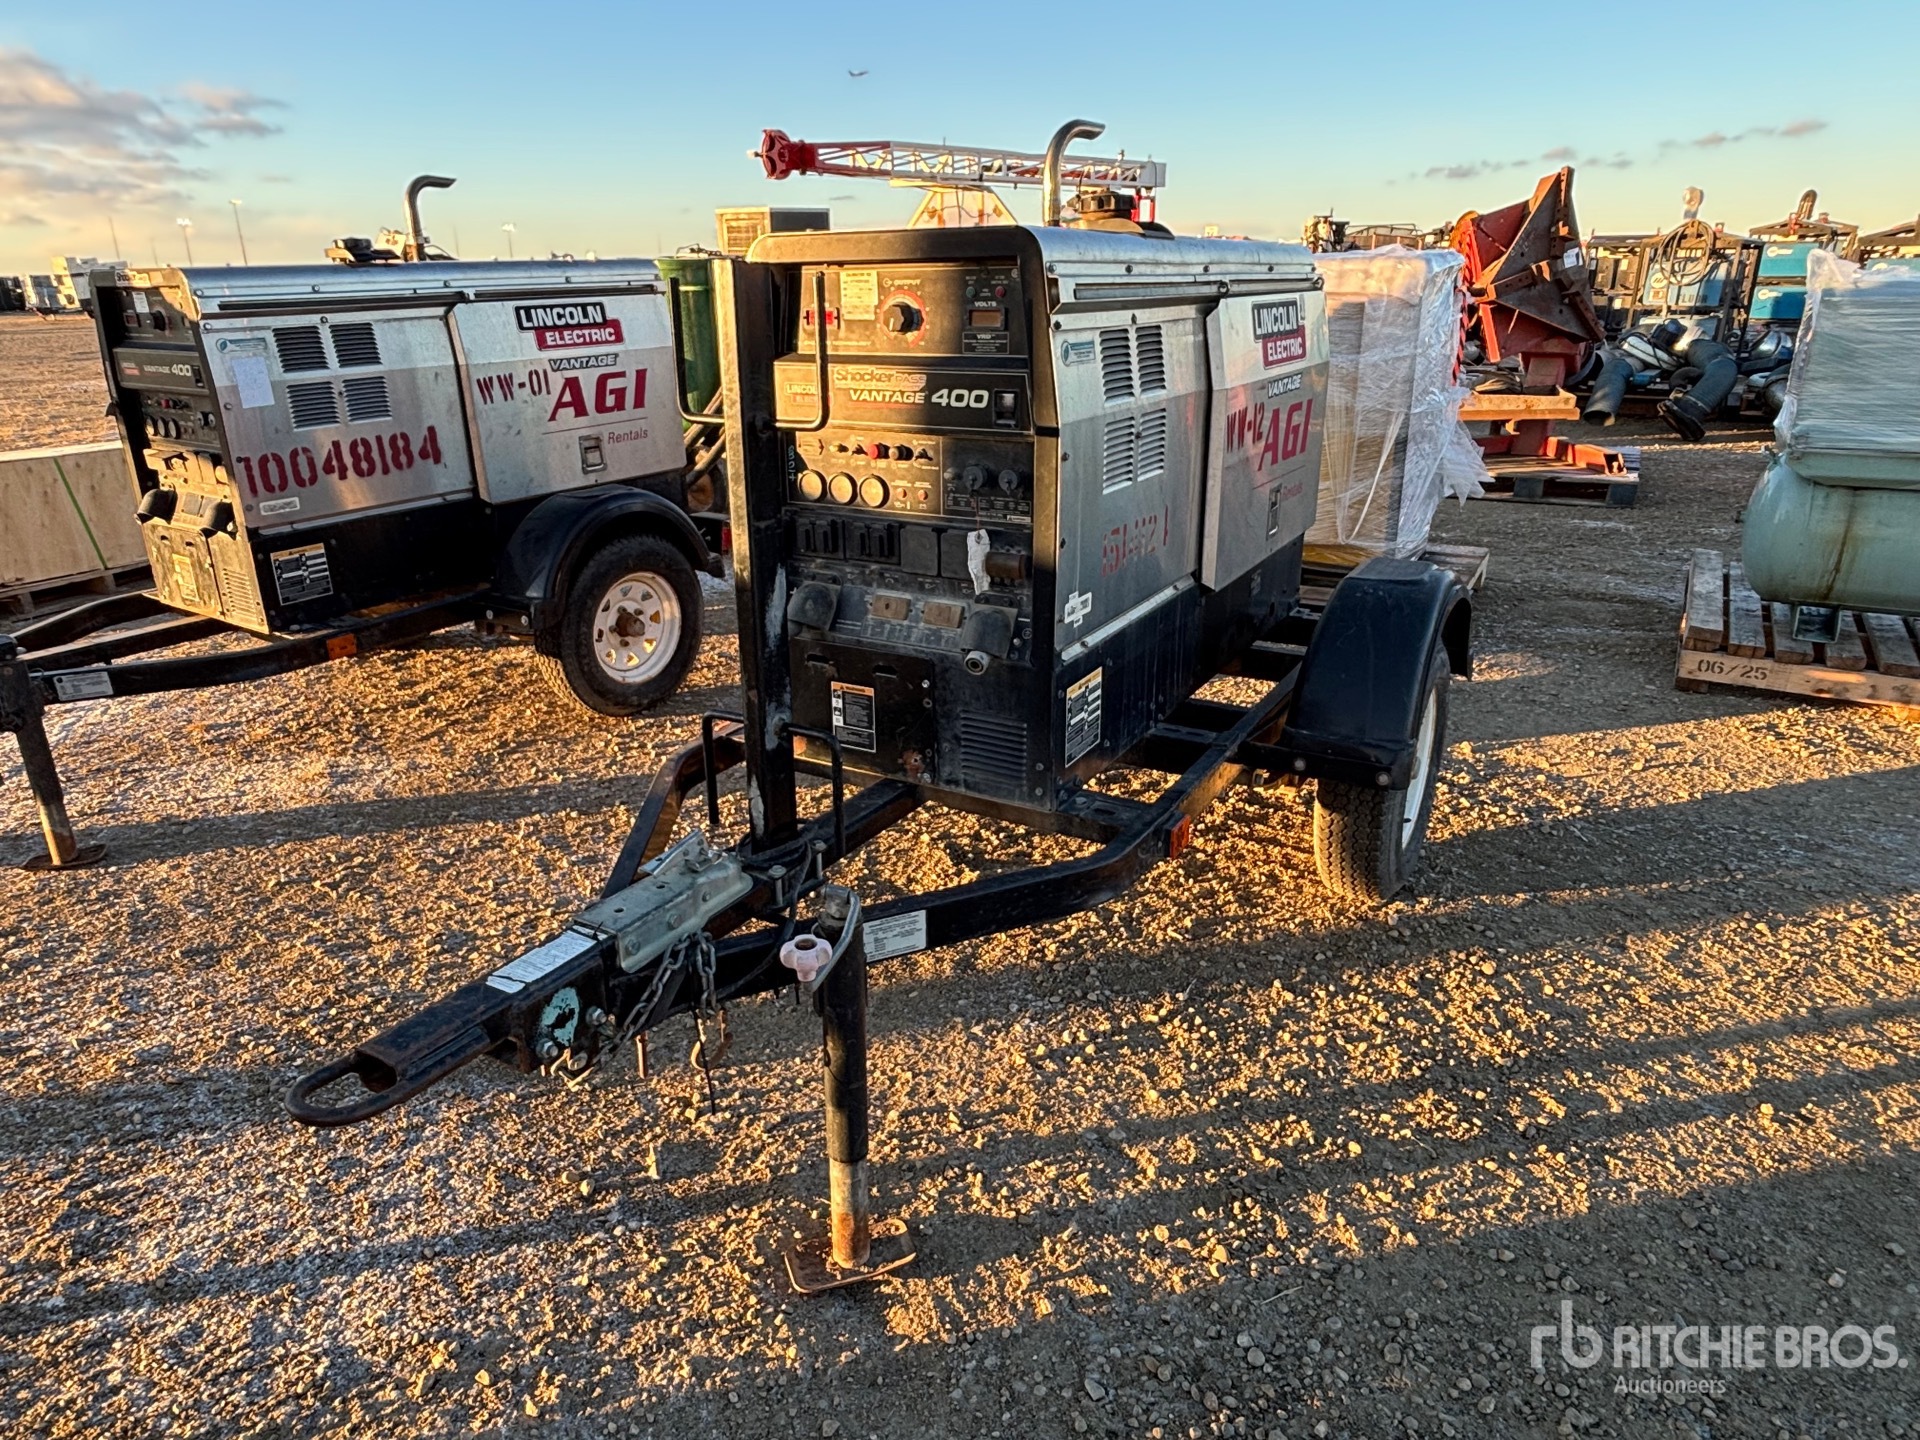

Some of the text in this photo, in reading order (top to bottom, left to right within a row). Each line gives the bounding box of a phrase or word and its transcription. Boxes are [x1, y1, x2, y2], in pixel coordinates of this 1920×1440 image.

[519, 306, 603, 328] LINCOLN
[1254, 304, 1297, 336] LINCOLN
[545, 328, 616, 346] ELECTRIC
[1267, 339, 1303, 362] ELECTRIC
[171, 363, 192, 377] 400
[550, 354, 616, 371] VANTAGE
[835, 369, 895, 382] Shocker
[1268, 374, 1302, 399] VANTAGE
[547, 368, 648, 422] AGI
[786, 384, 820, 395] LINCOL
[849, 389, 926, 404] VANTAGE
[931, 388, 990, 409] 400
[608, 428, 648, 445] Rentals
[1258, 398, 1314, 472] AGI
[241, 425, 442, 498] 10048184
[1697, 658, 1768, 681] 06/25
